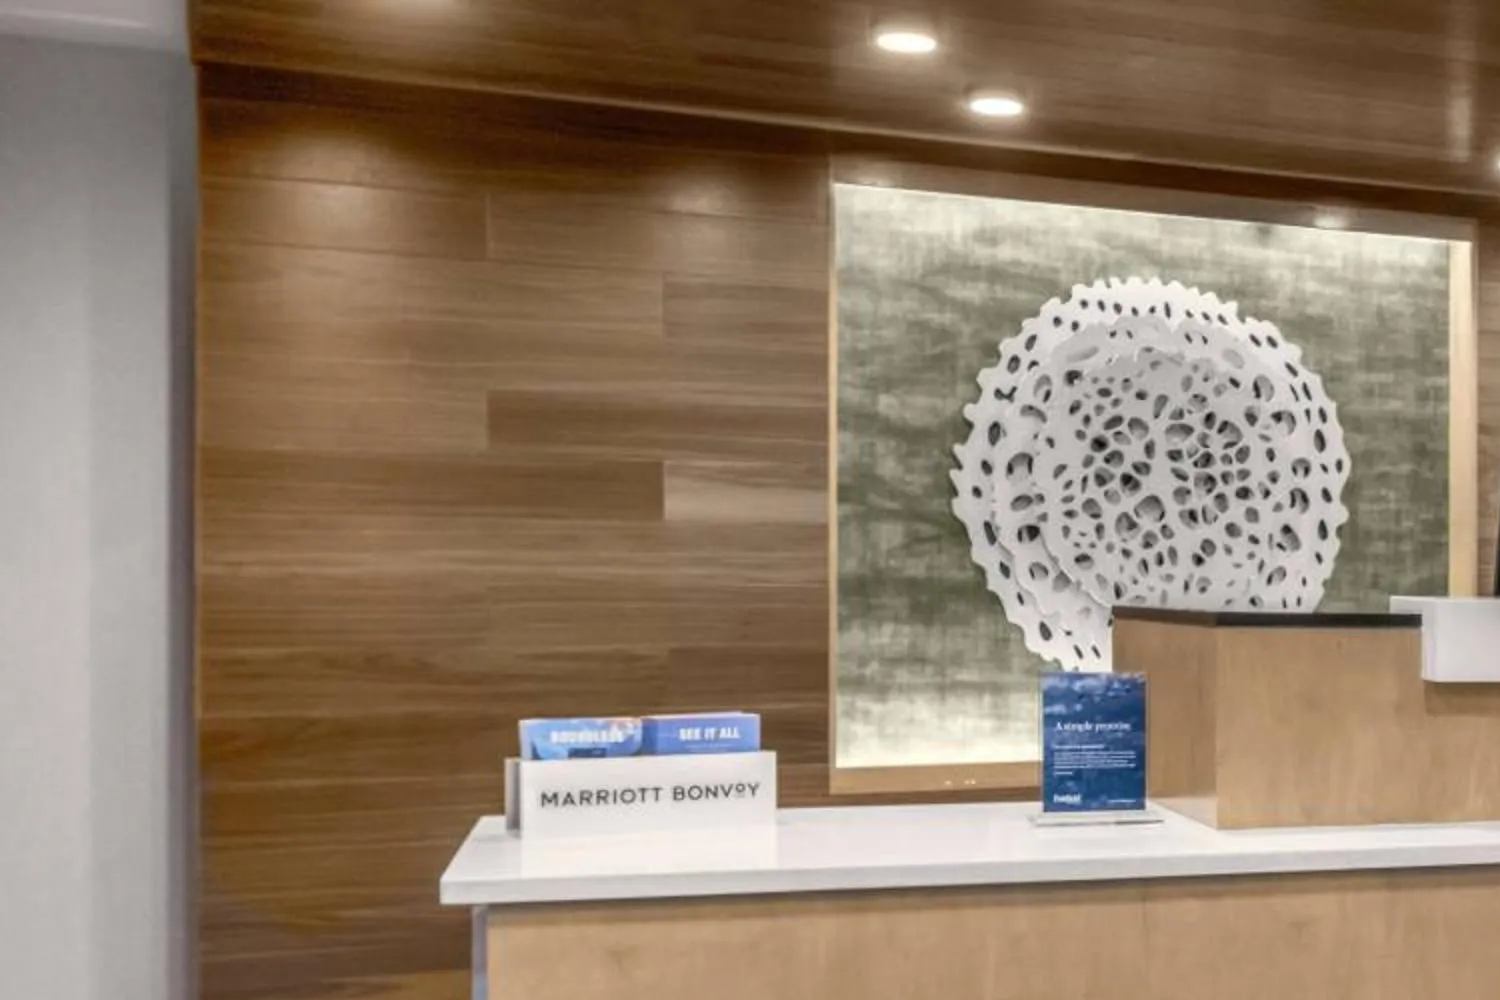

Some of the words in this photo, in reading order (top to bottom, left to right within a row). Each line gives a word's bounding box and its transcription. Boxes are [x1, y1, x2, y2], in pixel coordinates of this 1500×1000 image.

[679, 727, 701, 741] SEE
[704, 727, 716, 741] IT
[719, 726, 740, 739] ALL
[540, 787, 664, 808] MARRIOTT
[673, 782, 760, 801] BONVOY
